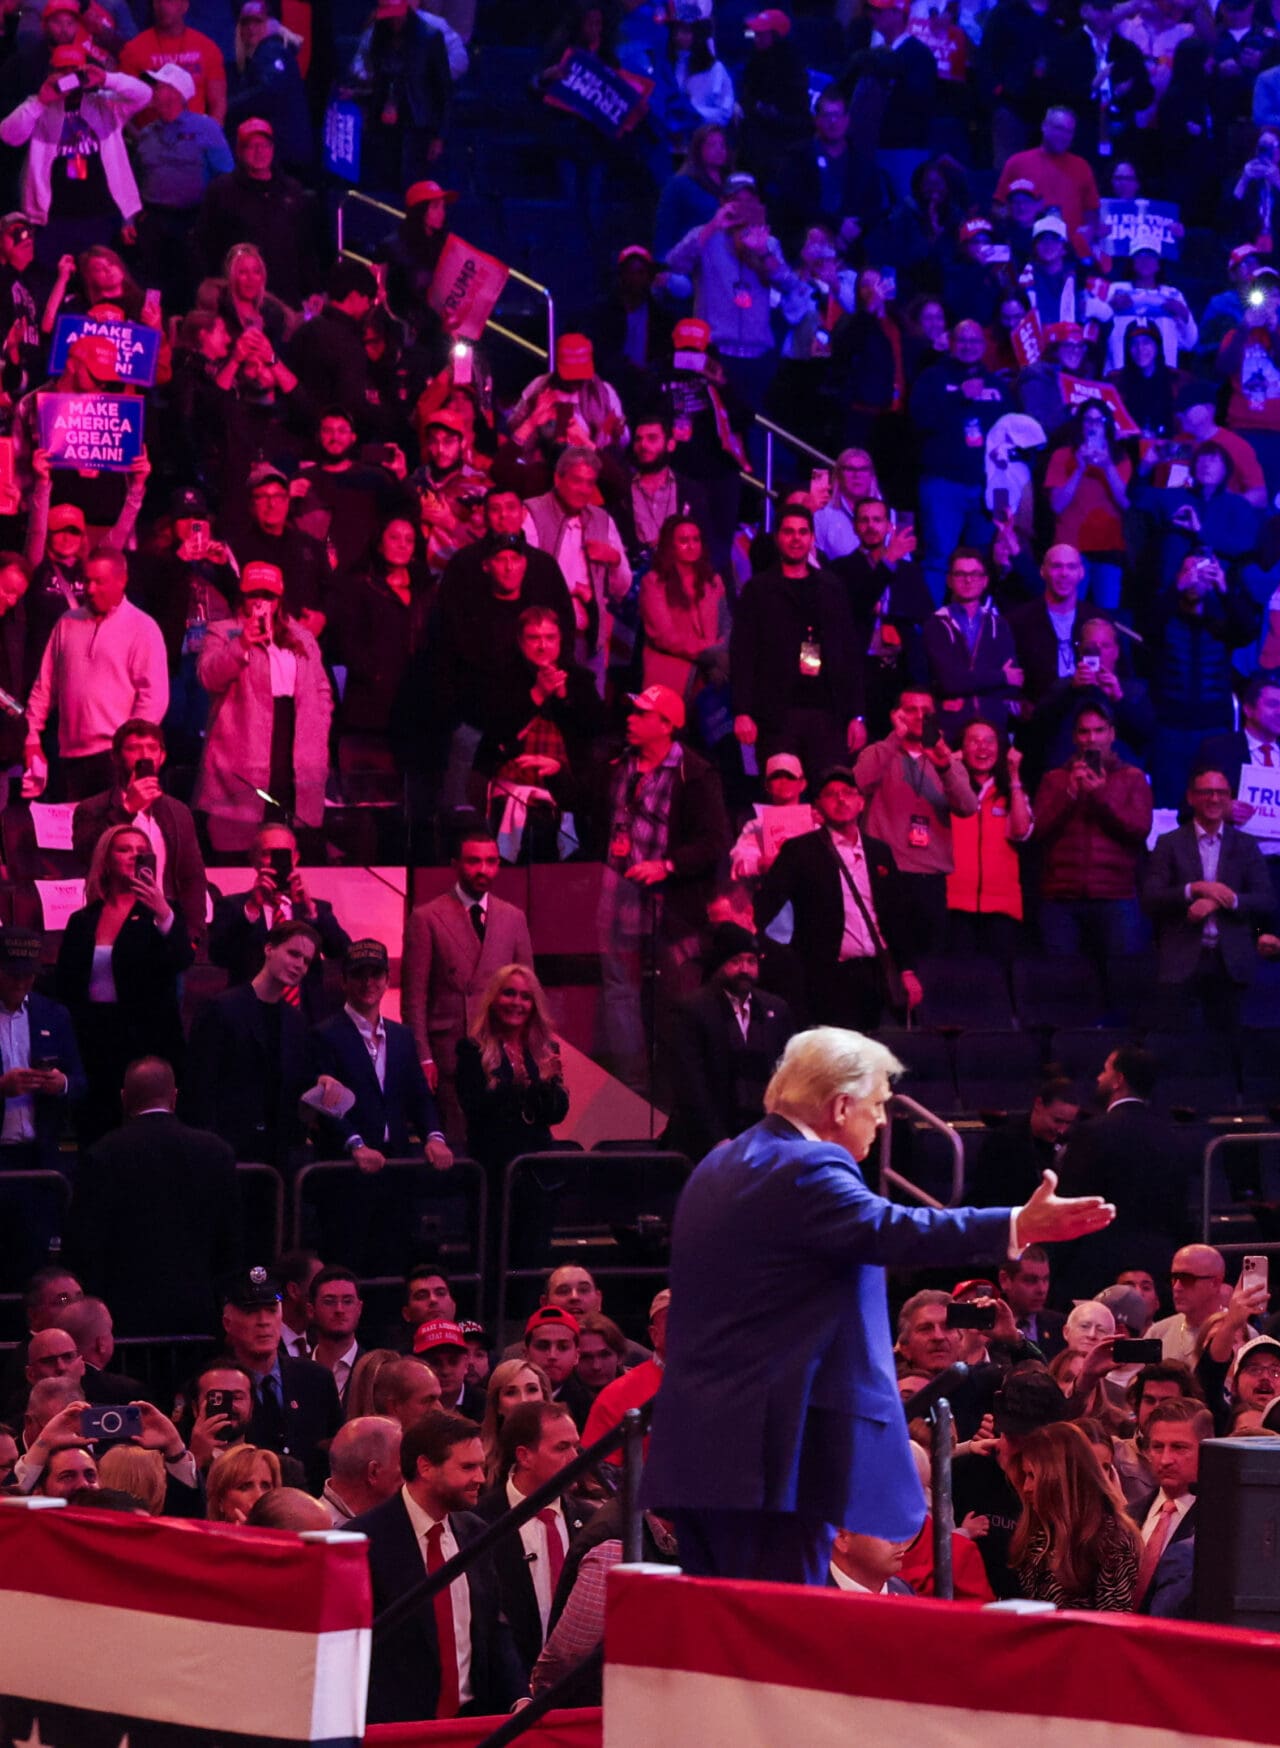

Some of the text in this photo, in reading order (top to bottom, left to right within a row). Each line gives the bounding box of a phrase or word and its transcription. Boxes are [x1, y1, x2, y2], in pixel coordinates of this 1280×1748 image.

[444, 259, 476, 310] RUMP
[83, 321, 133, 341] MAKE
[69, 401, 119, 417] MAKE
[53, 416, 133, 433] AMERICA
[65, 431, 122, 447] GREAT
[63, 445, 123, 462] AGAIN!
